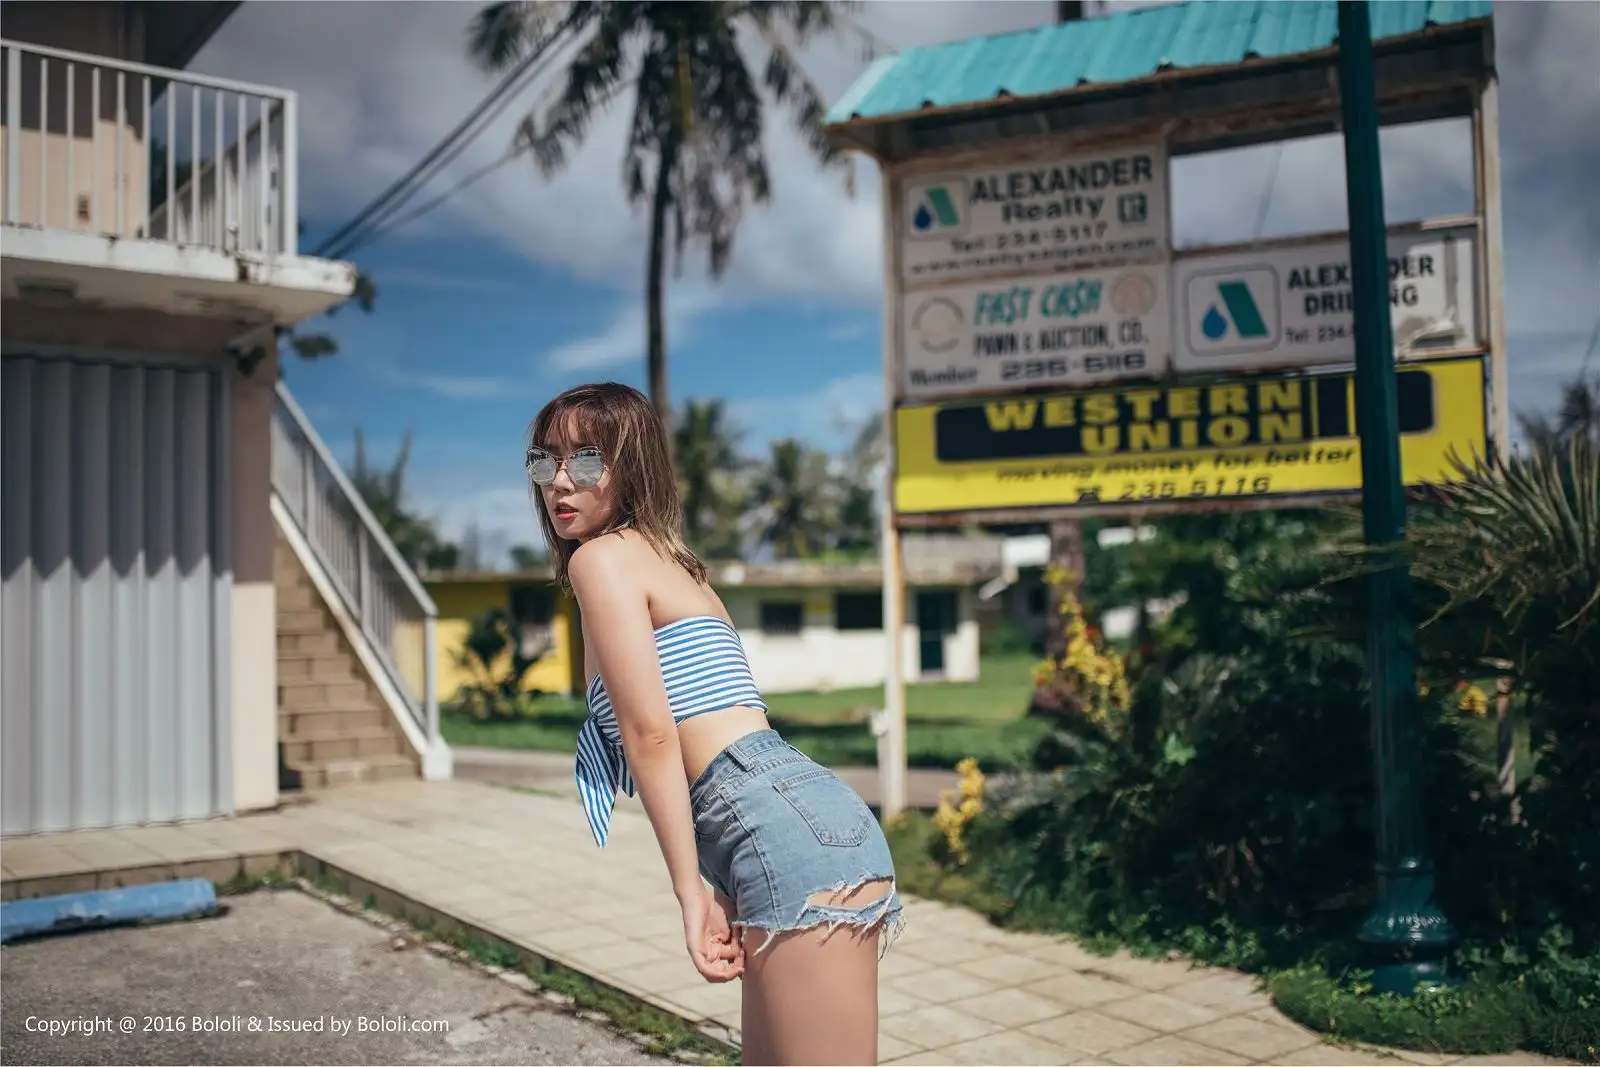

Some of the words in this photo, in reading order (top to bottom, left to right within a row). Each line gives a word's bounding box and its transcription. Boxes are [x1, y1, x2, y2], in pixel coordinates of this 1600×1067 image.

[970, 155, 1152, 203] ALEXANDER
[1003, 196, 1104, 223] Realty
[1288, 254, 1434, 289] ALEXDER
[973, 287, 1034, 326] FAST
[985, 379, 1301, 432] WESTERN
[1081, 413, 1301, 455] UNION
[996, 460, 1094, 483] moving
[1101, 456, 1198, 476] money
[1212, 451, 1255, 470] for
[1265, 445, 1357, 467] better
[1119, 482, 1174, 500] 235
[1188, 475, 1271, 498] 5116
